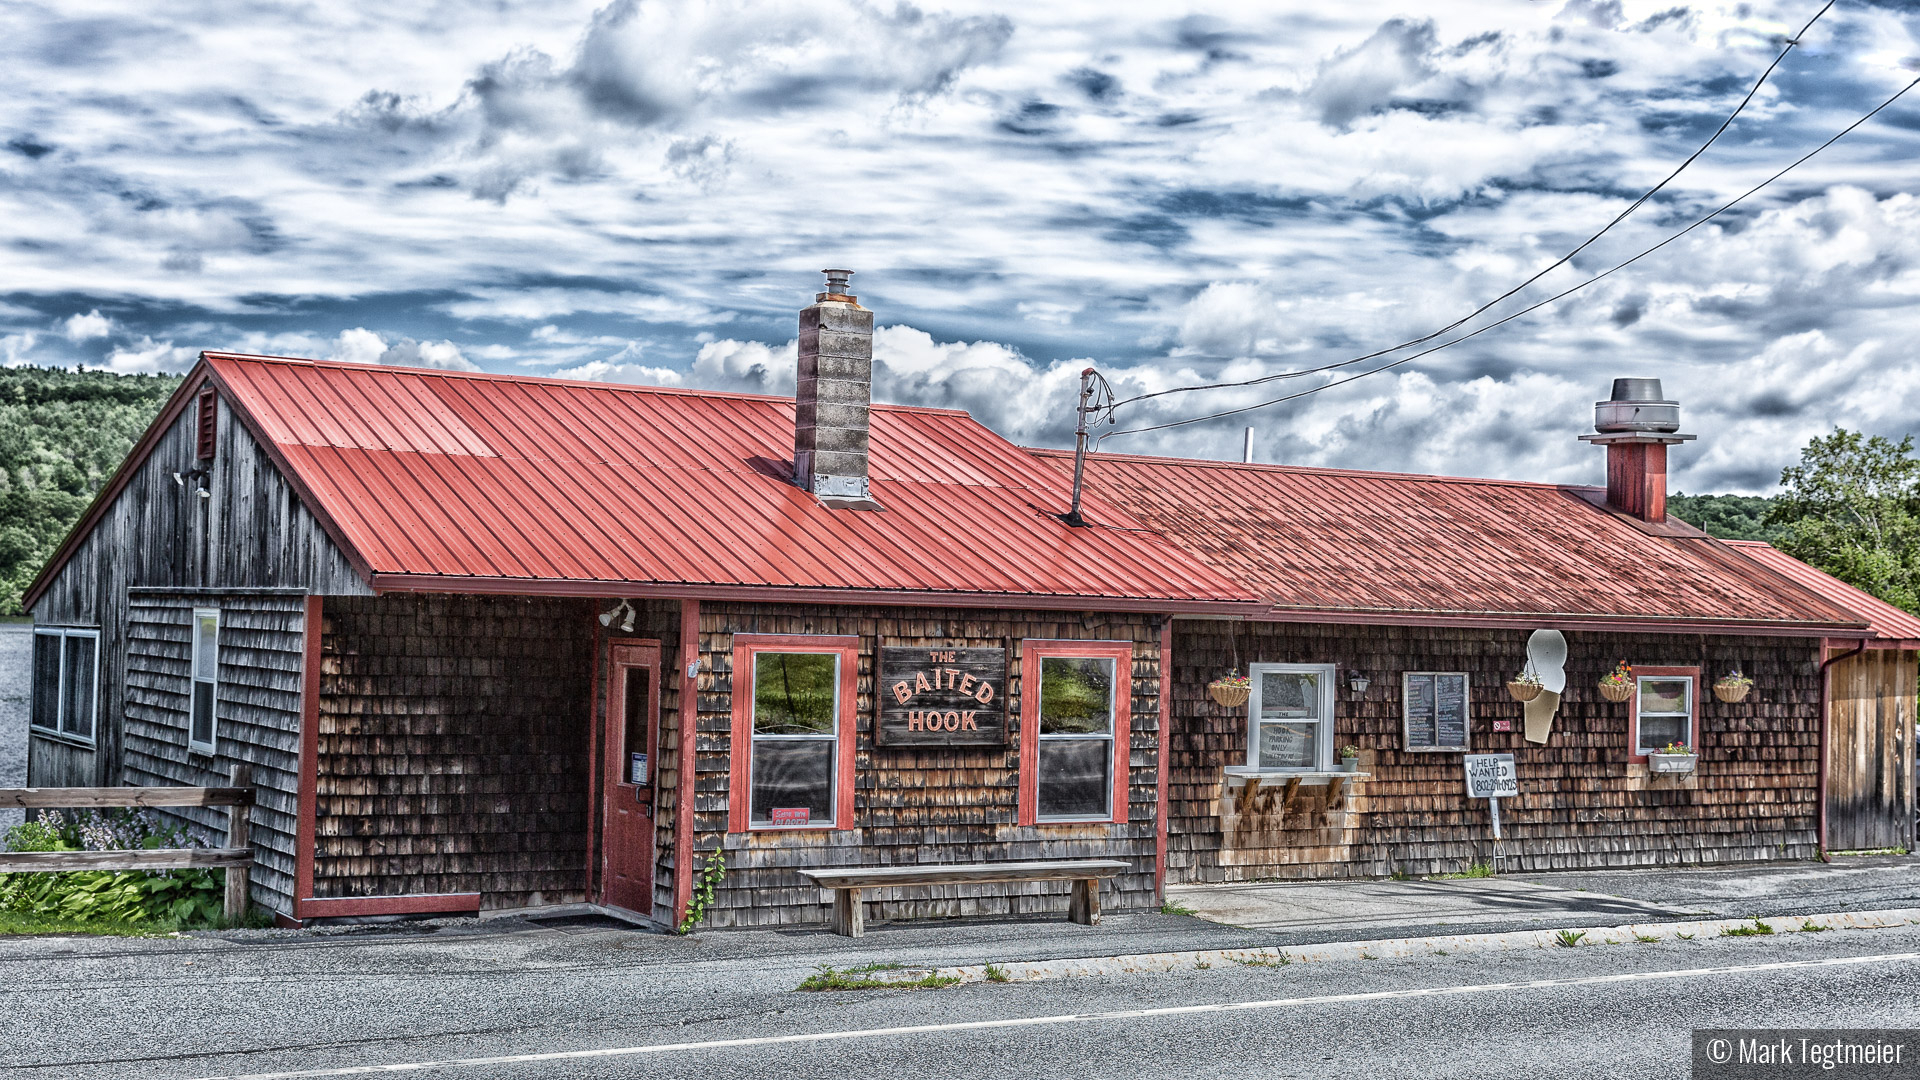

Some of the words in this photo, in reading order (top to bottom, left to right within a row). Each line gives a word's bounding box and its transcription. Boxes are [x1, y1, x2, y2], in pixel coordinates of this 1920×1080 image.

[930, 651, 956, 663] THE
[892, 668, 994, 705] BAITED
[908, 710, 978, 732] HOOK
[1268, 735, 1293, 743] PARKING
[1476, 757, 1499, 768] HELP
[1469, 766, 1508, 778] WANTED
